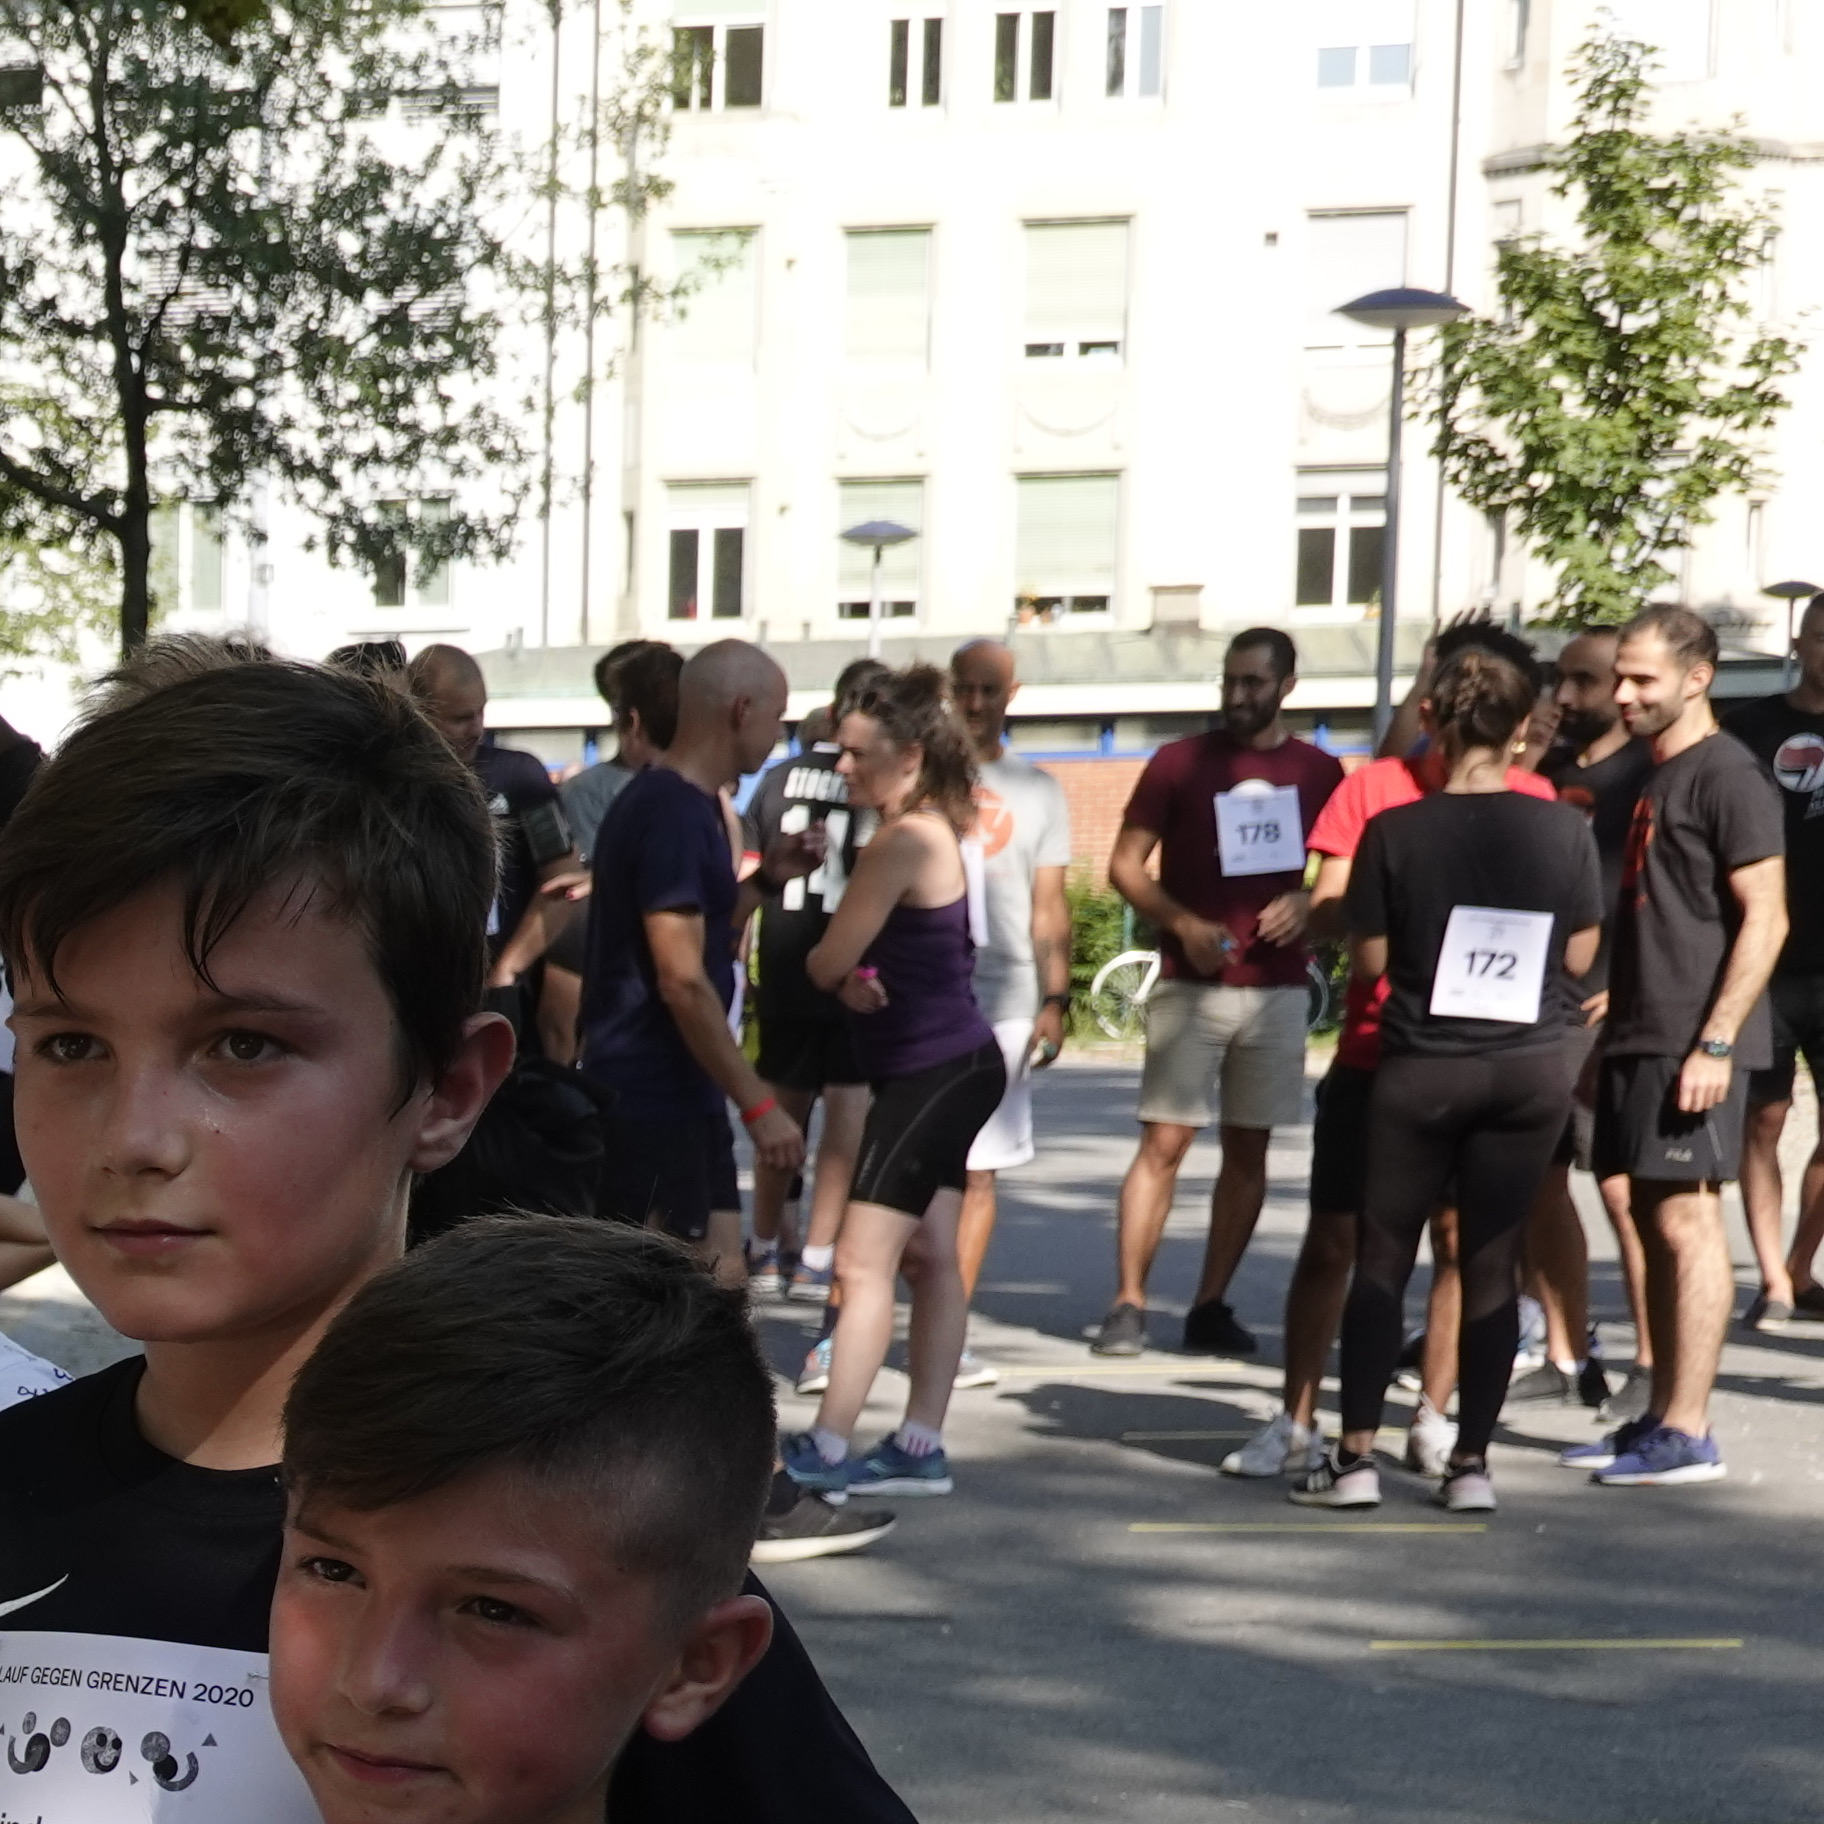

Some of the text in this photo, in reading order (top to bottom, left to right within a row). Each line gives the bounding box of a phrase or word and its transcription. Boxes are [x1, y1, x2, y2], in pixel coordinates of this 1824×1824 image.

[1236, 821, 1281, 845] 178
[1465, 949, 1518, 980] 172
[30, 1667, 81, 1688] GEGEN
[87, 1671, 187, 1698] GRENZEN
[192, 1683, 253, 1708] 2020
